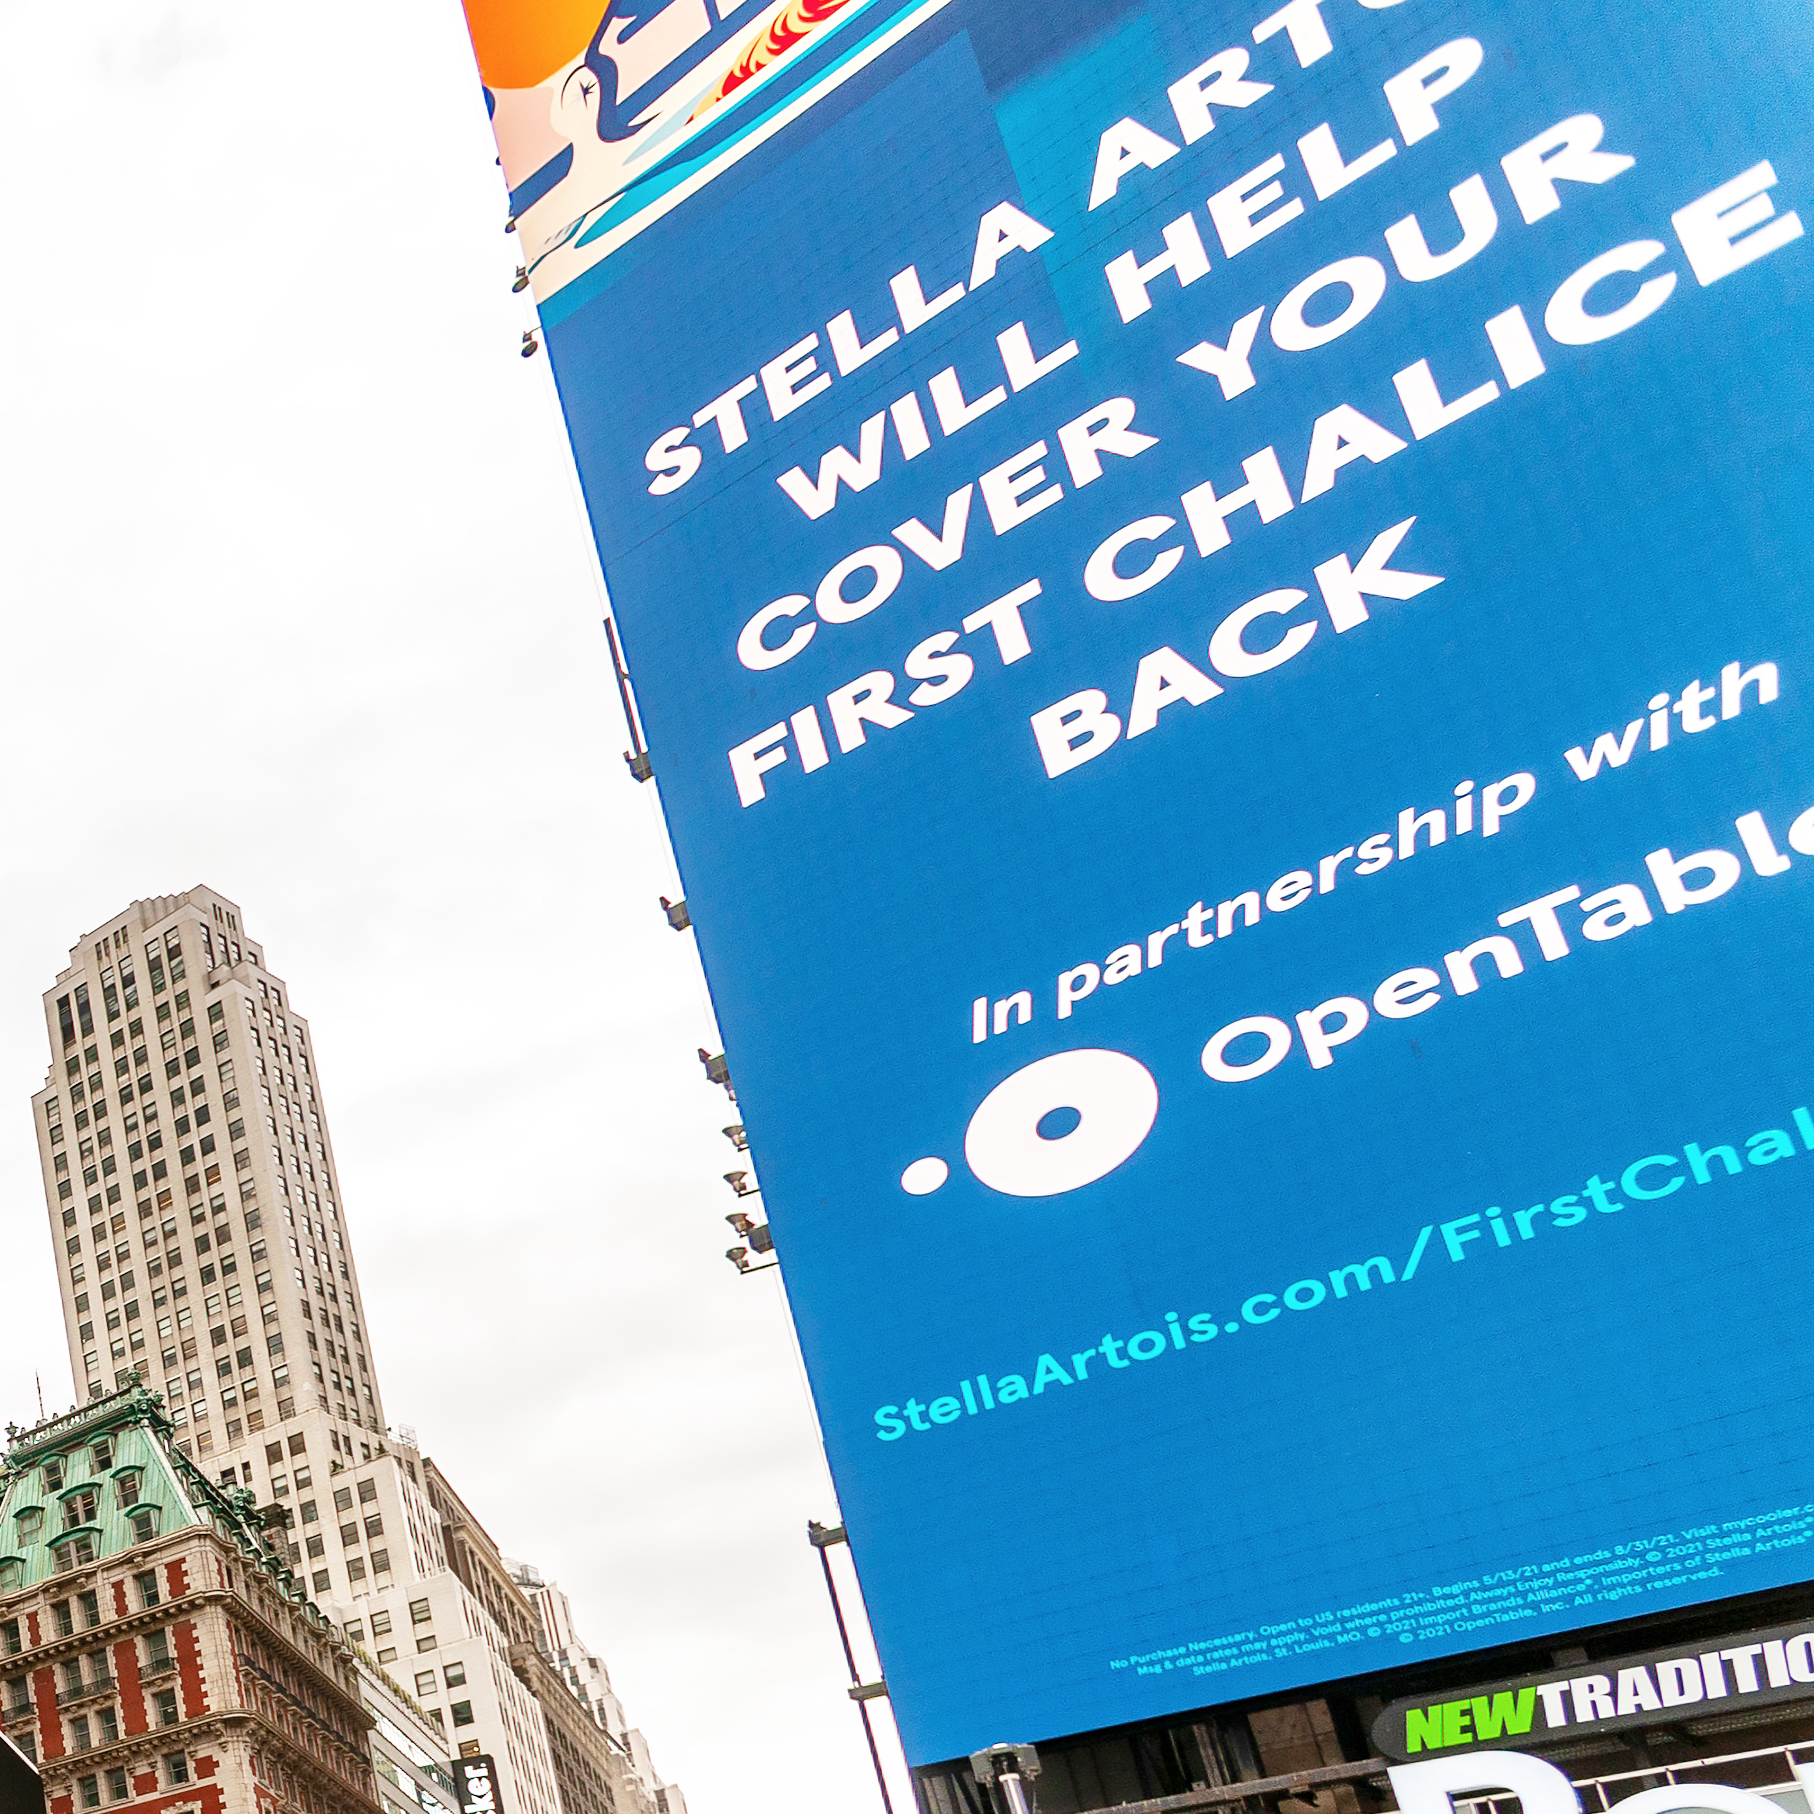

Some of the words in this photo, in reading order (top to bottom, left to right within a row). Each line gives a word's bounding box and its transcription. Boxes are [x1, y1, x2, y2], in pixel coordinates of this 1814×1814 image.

[646, 202, 1055, 496] STELLA
[1088, 0, 1408, 211] ART
[738, 398, 1159, 670] COVER
[1176, 114, 1635, 400] YOUR
[777, 322, 1079, 519] WILL
[1105, 38, 1483, 323] HELP
[729, 579, 1042, 807] FIRST
[1084, 160, 1804, 601] CHALICE
[1031, 516, 1445, 778] BACK
[974, 991, 1031, 1043] In
[1058, 773, 1535, 1019] partnership
[1564, 662, 1778, 781] with
[1130, 1645, 1187, 1666] Purchase
[1260, 1621, 1296, 1637] Open
[1298, 1615, 1313, 1627] to
[1315, 1611, 1333, 1623] US
[1337, 1597, 1400, 1618] residents
[1432, 1579, 1480, 1597] Begins
[1482, 1565, 1538, 1585] 5/13/21
[1542, 1557, 1570, 1572] and
[1573, 1550, 1611, 1565] ends
[1681, 1524, 1719, 1539] Visit
[1176, 1654, 1205, 1668] data
[1206, 1646, 1240, 1661] rates
[1241, 1639, 1268, 1654] may
[1270, 1631, 1309, 1649] apply.
[1311, 1622, 1342, 1638] Void
[1344, 1612, 1388, 1630] where
[1389, 1594, 1468, 1621] prohibited.
[1469, 1585, 1516, 1602] Always
[1517, 1575, 1555, 1593] Enjoy
[1556, 1555, 1643, 1582] Responsibly.
[1667, 1541, 1703, 1558] 2021
[1706, 1532, 1752, 1549] Stella
[1192, 1661, 1228, 1676] Stella
[1384, 1618, 1417, 1634] 2021
[1419, 1607, 1469, 1627] Import
[1471, 1596, 1524, 1614] Brands
[1601, 1562, 1682, 1586] Importers
[1684, 1555, 1702, 1568] of
[1705, 1547, 1752, 1563] Stella
[1417, 1624, 1451, 1640] 2021
[1541, 1601, 1570, 1613] Inc.
[1574, 1593, 1594, 1607] All
[1597, 1584, 1643, 1600] rights
[1646, 1567, 1724, 1590] reserved.
